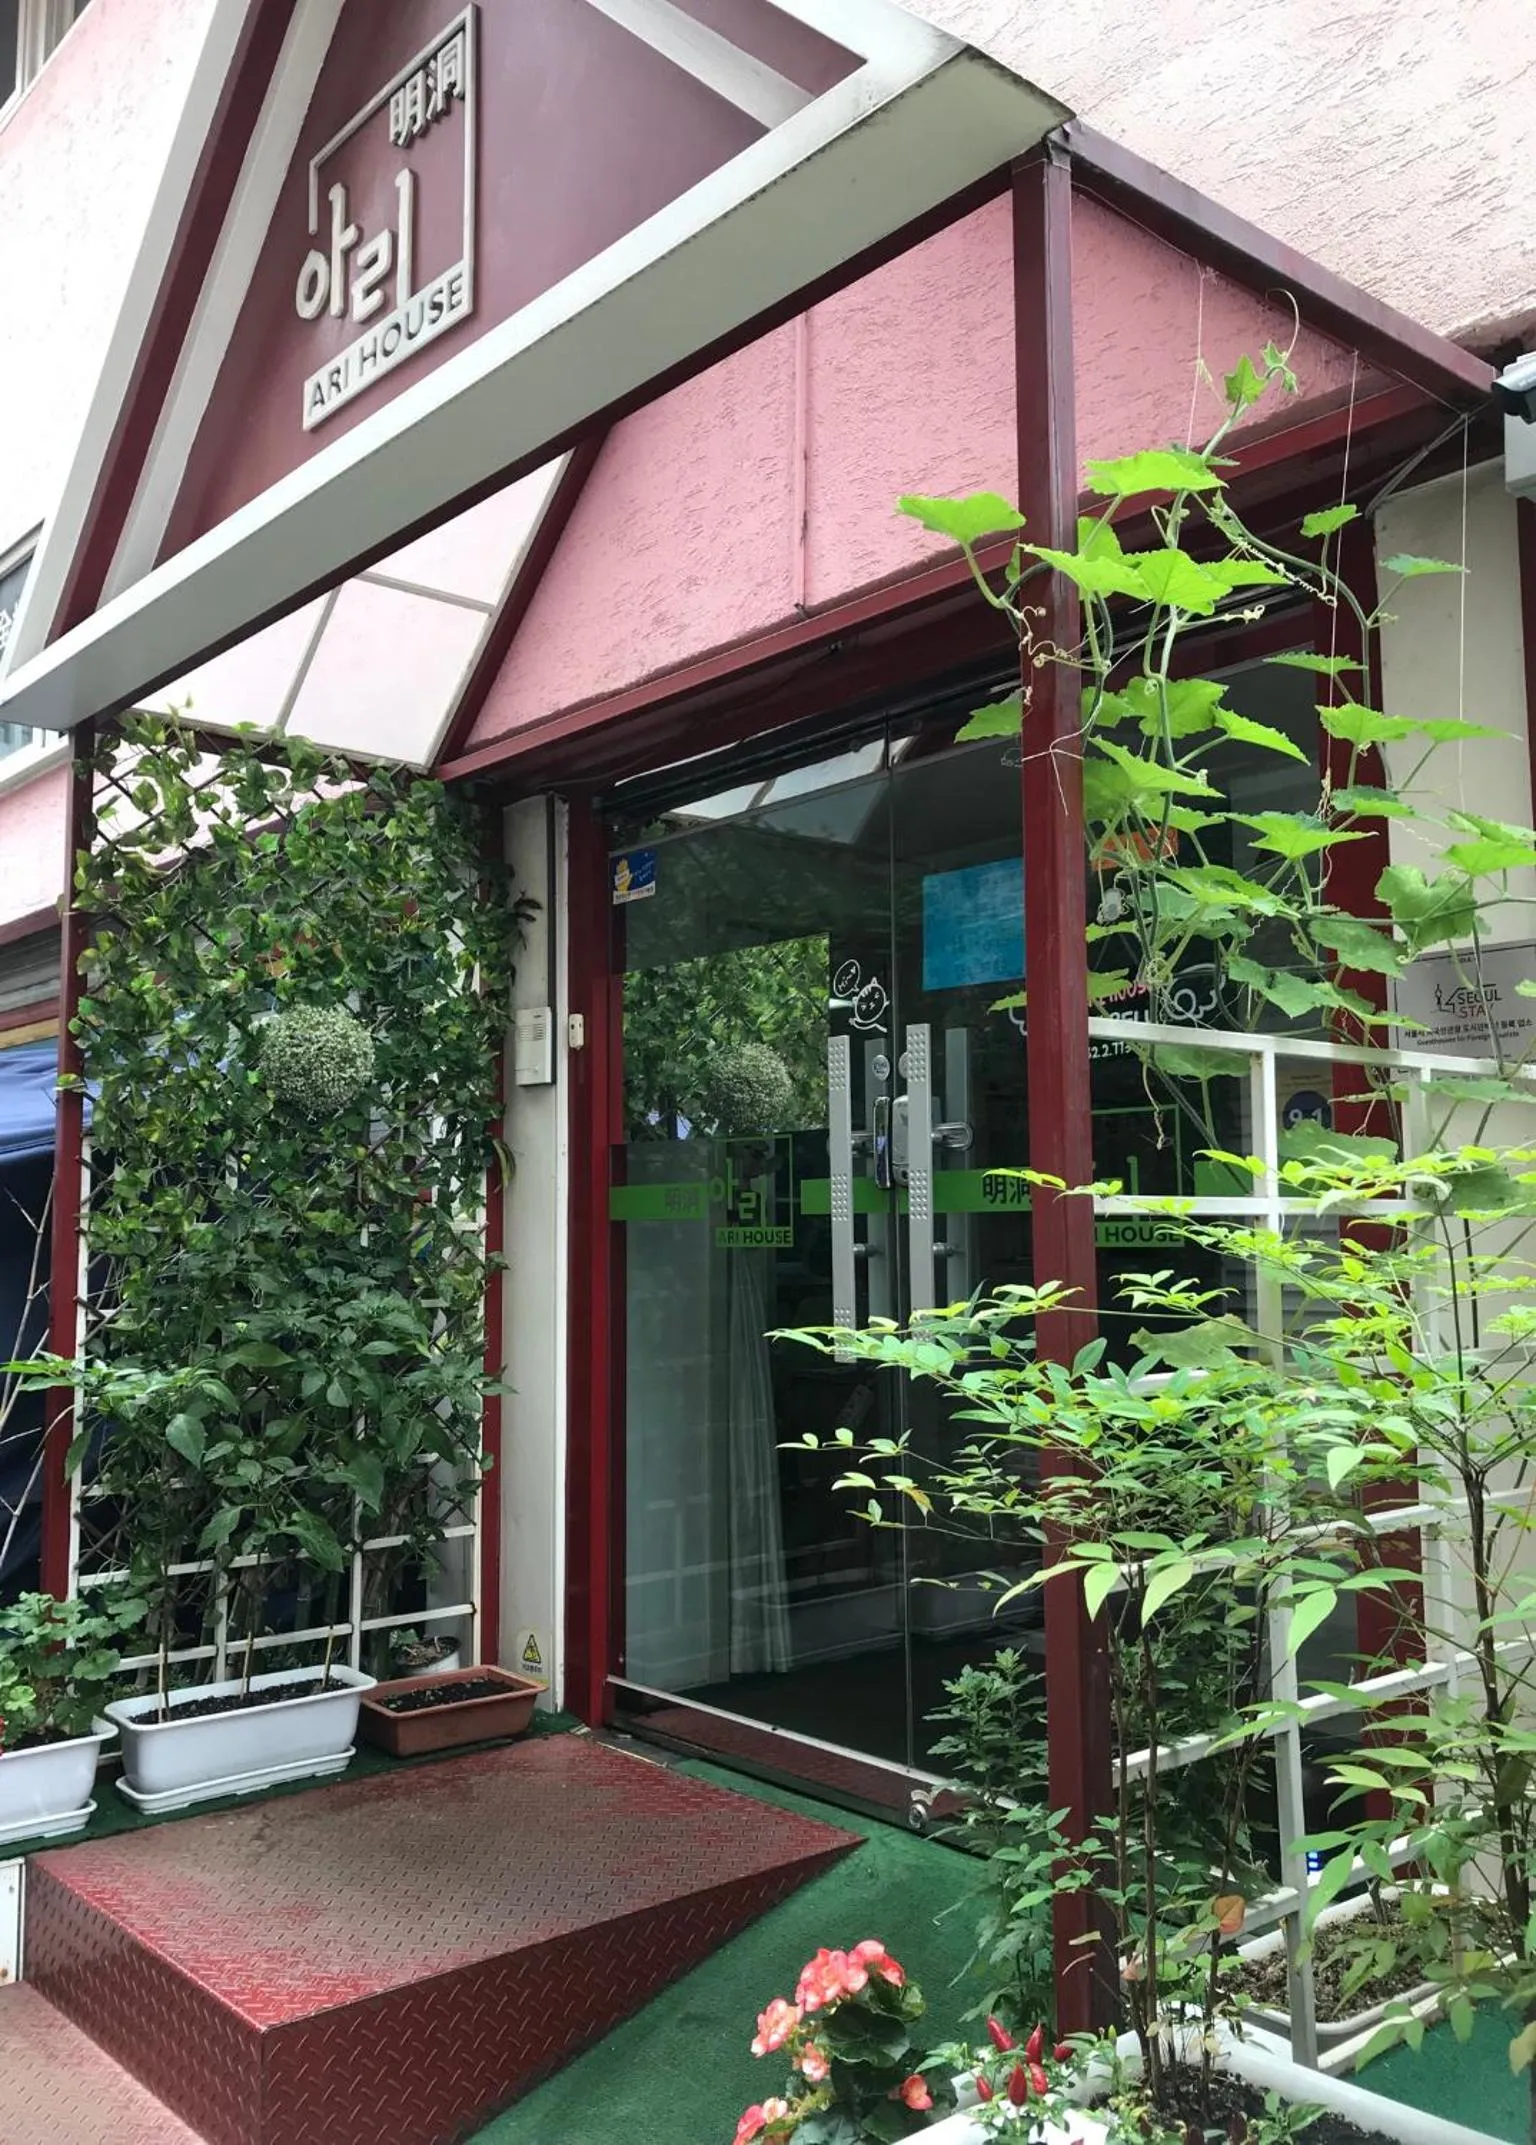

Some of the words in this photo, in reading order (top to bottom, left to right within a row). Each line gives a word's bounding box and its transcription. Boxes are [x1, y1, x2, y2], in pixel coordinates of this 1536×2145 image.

[389, 29, 465, 147] 明洞
[296, 166, 414, 324] 아리
[307, 365, 350, 417] ARI
[357, 270, 464, 377] HOUSE
[709, 1157, 768, 1228] 아리
[718, 1230, 739, 1244] ARI
[743, 1229, 792, 1244] HOUSE
[1105, 1225, 1181, 1243] HOUSE
